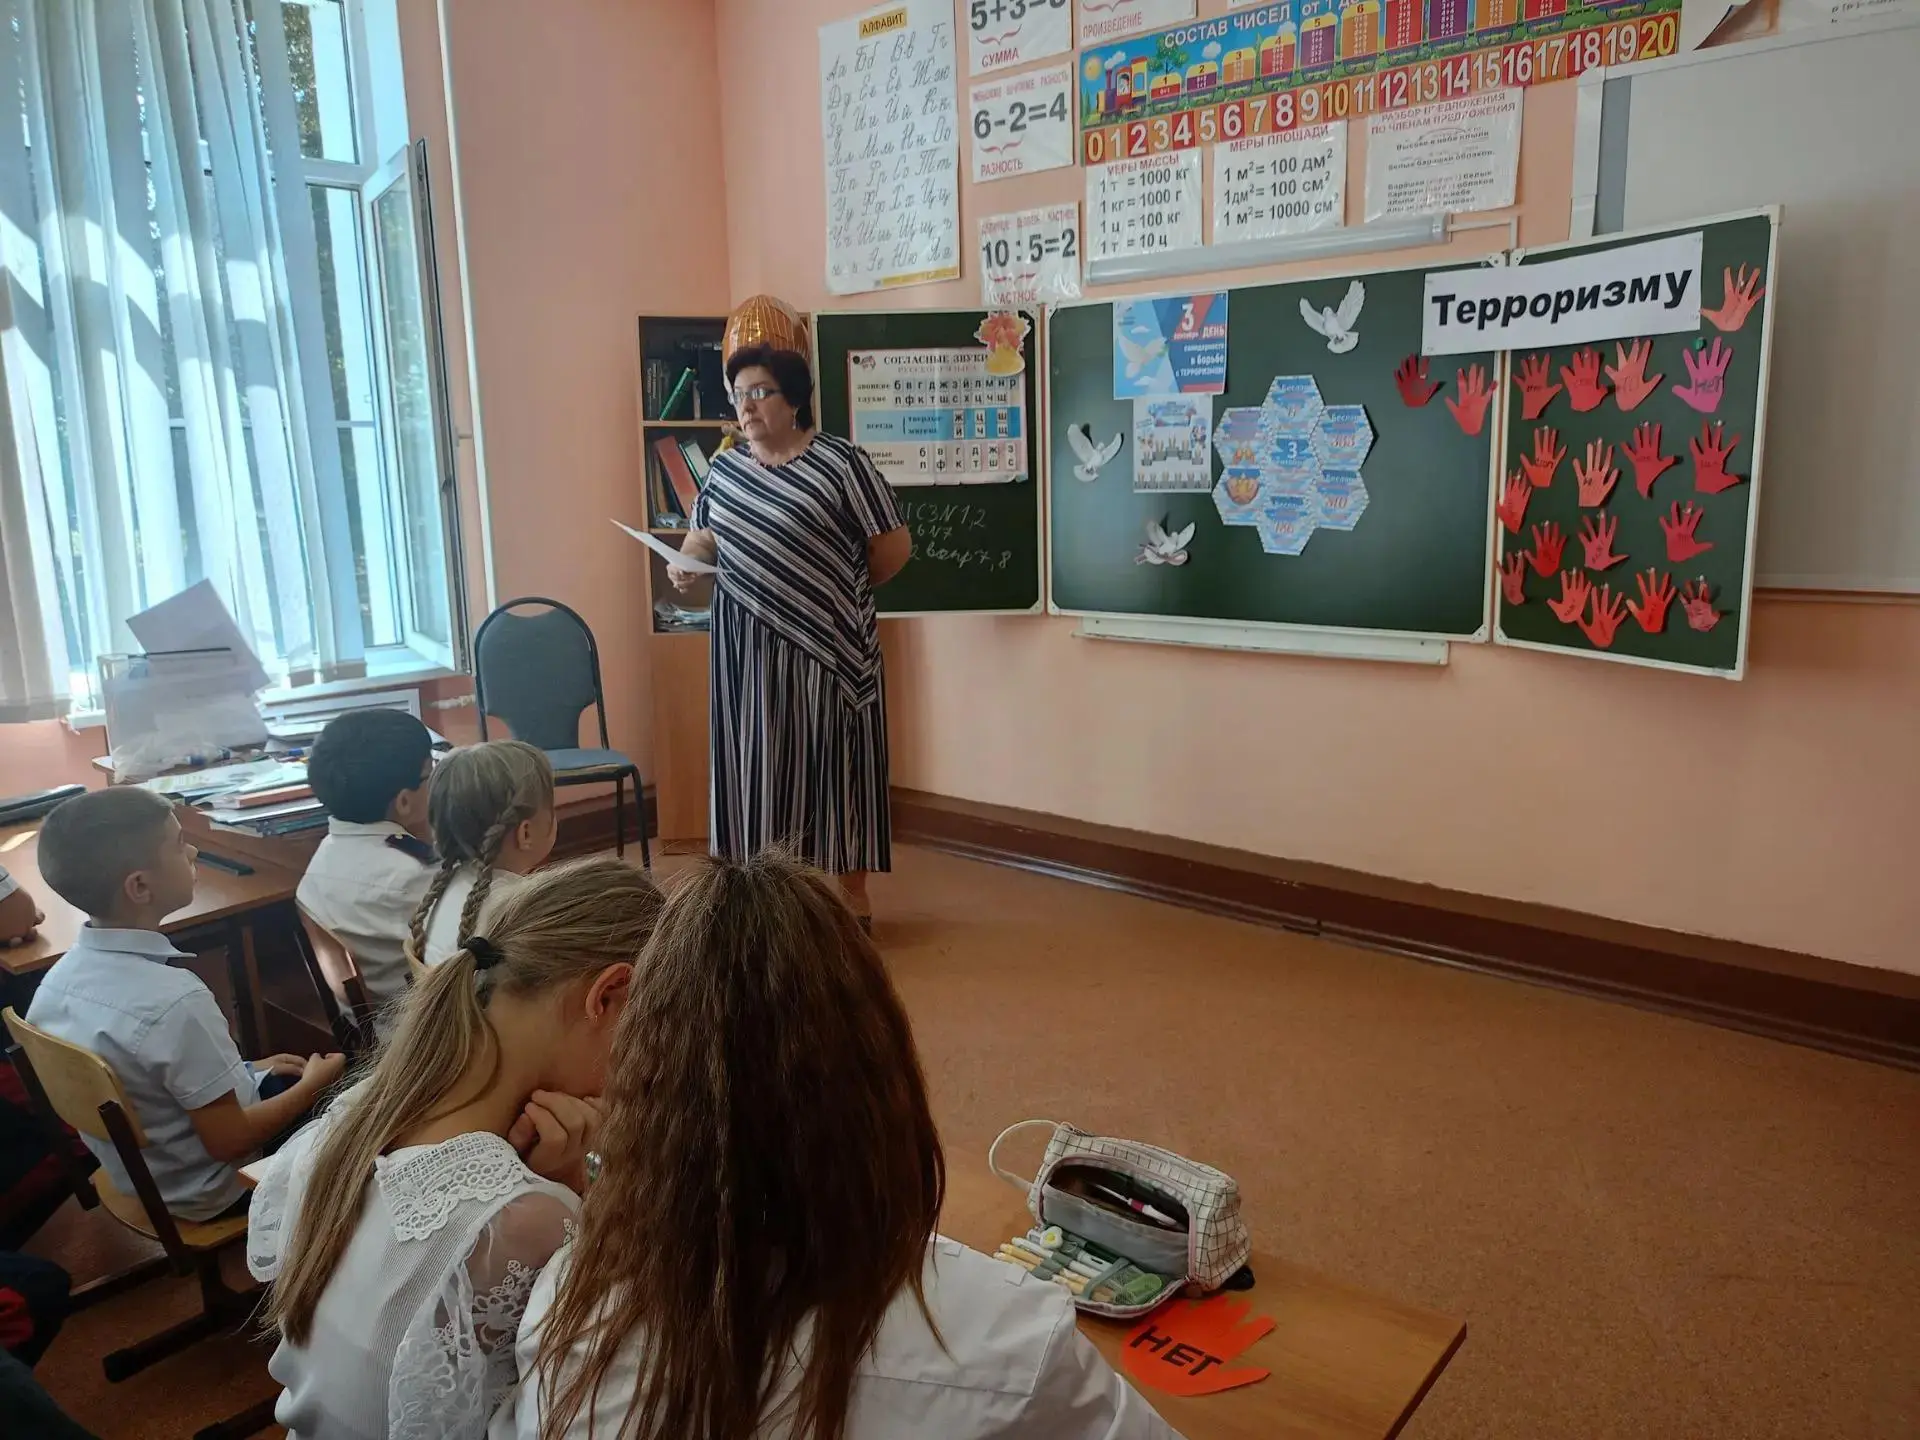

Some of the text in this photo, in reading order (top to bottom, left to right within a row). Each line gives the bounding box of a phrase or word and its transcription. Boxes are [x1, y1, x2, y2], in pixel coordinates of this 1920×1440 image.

[862, 12, 904, 35] АЛФАВИТ
[1082, 12, 1143, 38] ПРОИЗВЕДЕНИЕ
[1165, 20, 1228, 48] СОСТАВ
[1233, 5, 1291, 31] ЧИСЕЛ
[982, 48, 1019, 68] СУММА
[1088, 16, 1676, 162] 0 1 2 3 4 5 6 7 8 9 10 11 12 13 14 15 16 17 18 19 20
[1381, 108, 1421, 122] РАЗБОР
[1371, 125, 1386, 135] ПО
[1389, 117, 1431, 132] ЧЛЕНАМ
[1230, 125, 1329, 153] МЕРЫ ПЛОЩАДИ
[980, 158, 1024, 177] РАЗНОСТЬ
[1139, 154, 1179, 171] МАССЫ
[1270, 157, 1297, 175] 100
[1139, 169, 1171, 187] 1000
[1175, 168, 1189, 181] кг
[1140, 188, 1171, 206] 1000
[1270, 180, 1297, 197] 100
[1140, 211, 1163, 228] 100
[1167, 211, 1181, 224] кг
[1268, 200, 1310, 220] 10000
[1140, 232, 1155, 248] 10
[1159, 234, 1168, 247] ц
[1432, 269, 1693, 331] Терроризму
[1181, 303, 1194, 331] 3
[1202, 326, 1225, 338] ДЕНЬ
[884, 353, 949, 365] СОГЛАСНЫЕ
[1287, 441, 1298, 459] 3
[1130, 1325, 1224, 1375] НЕТ
